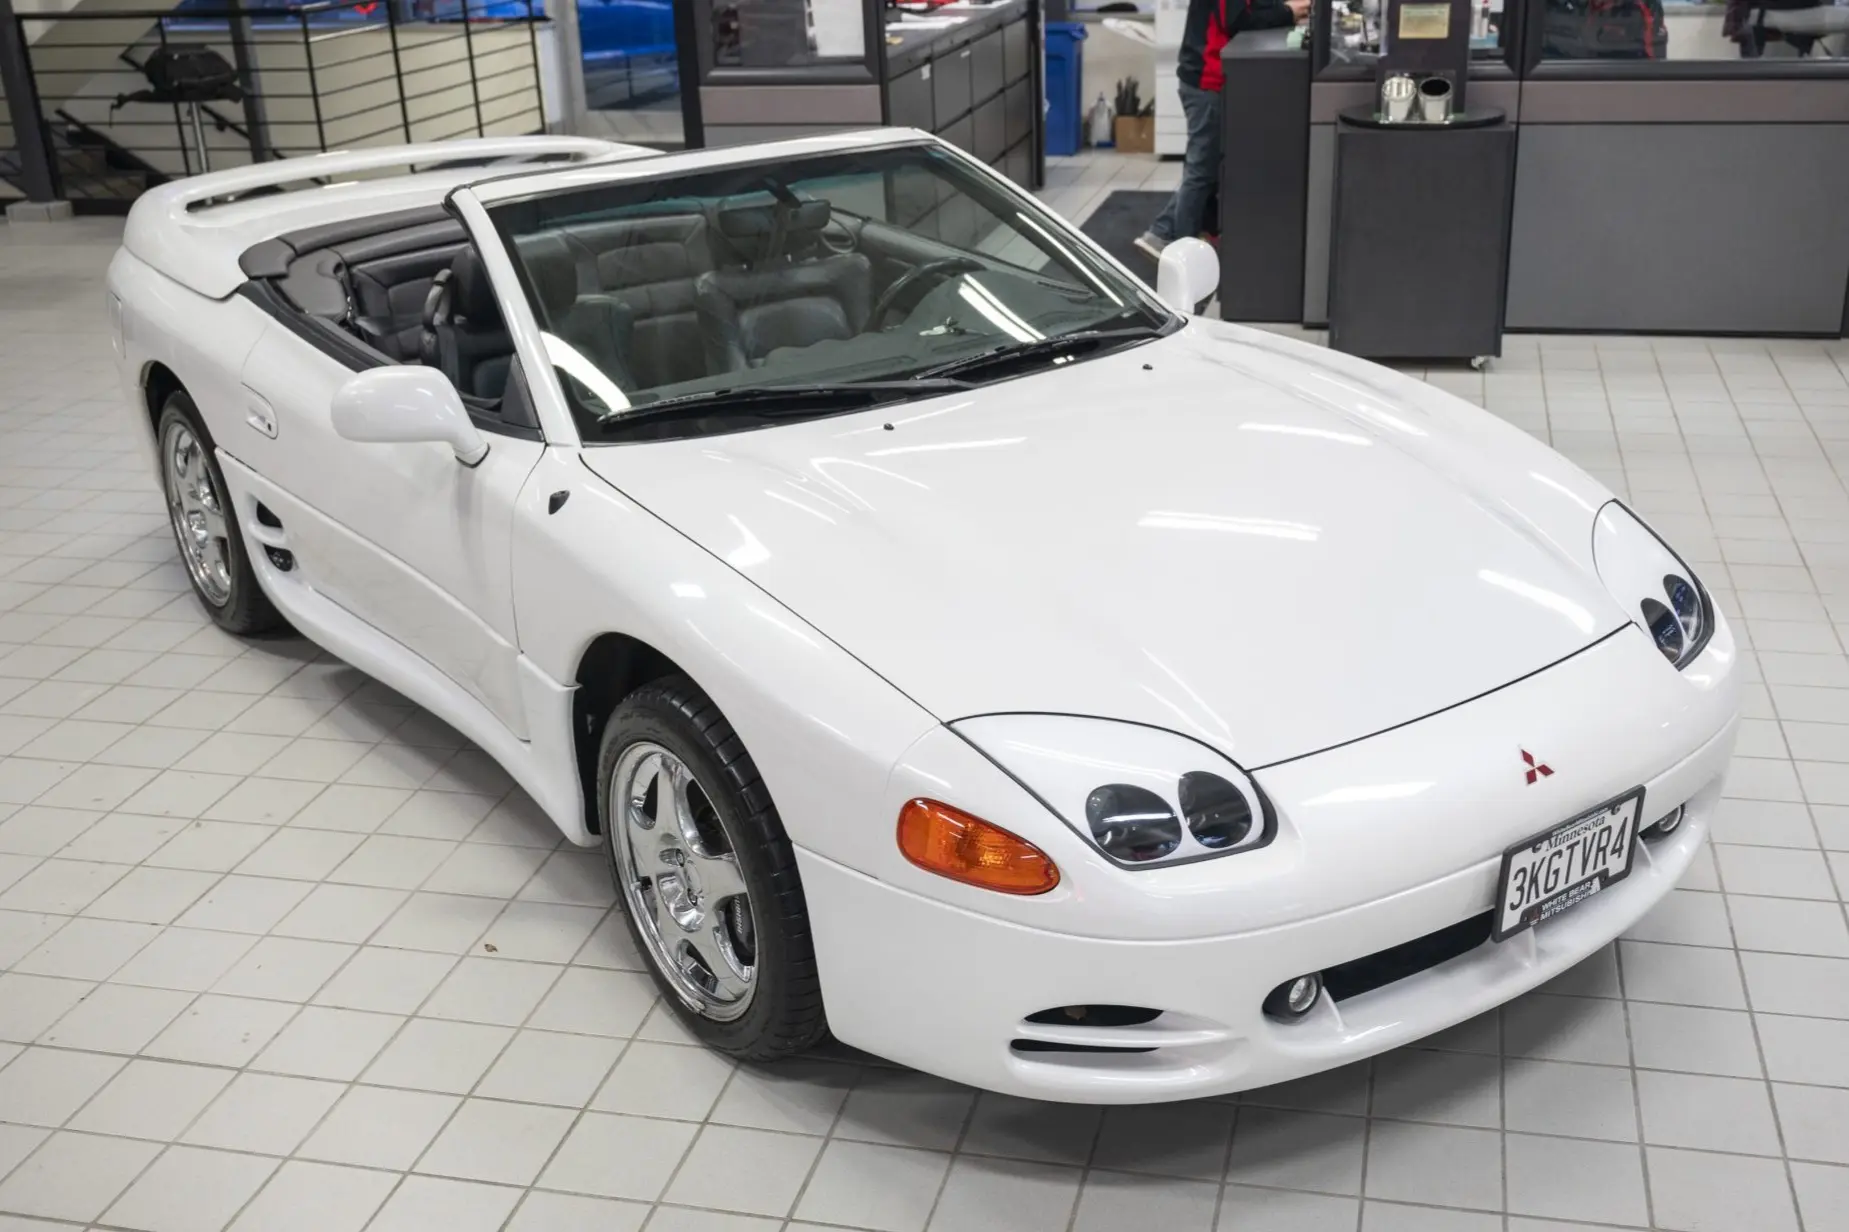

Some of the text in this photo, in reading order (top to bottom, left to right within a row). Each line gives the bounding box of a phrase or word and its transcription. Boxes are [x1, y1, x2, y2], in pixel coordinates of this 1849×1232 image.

[1545, 815, 1606, 851] Minnesota
[1509, 816, 1628, 911] 3KGTVR4
[1540, 890, 1591, 921] MITSUBISHI
[1541, 881, 1592, 911] WHITE BEAR
